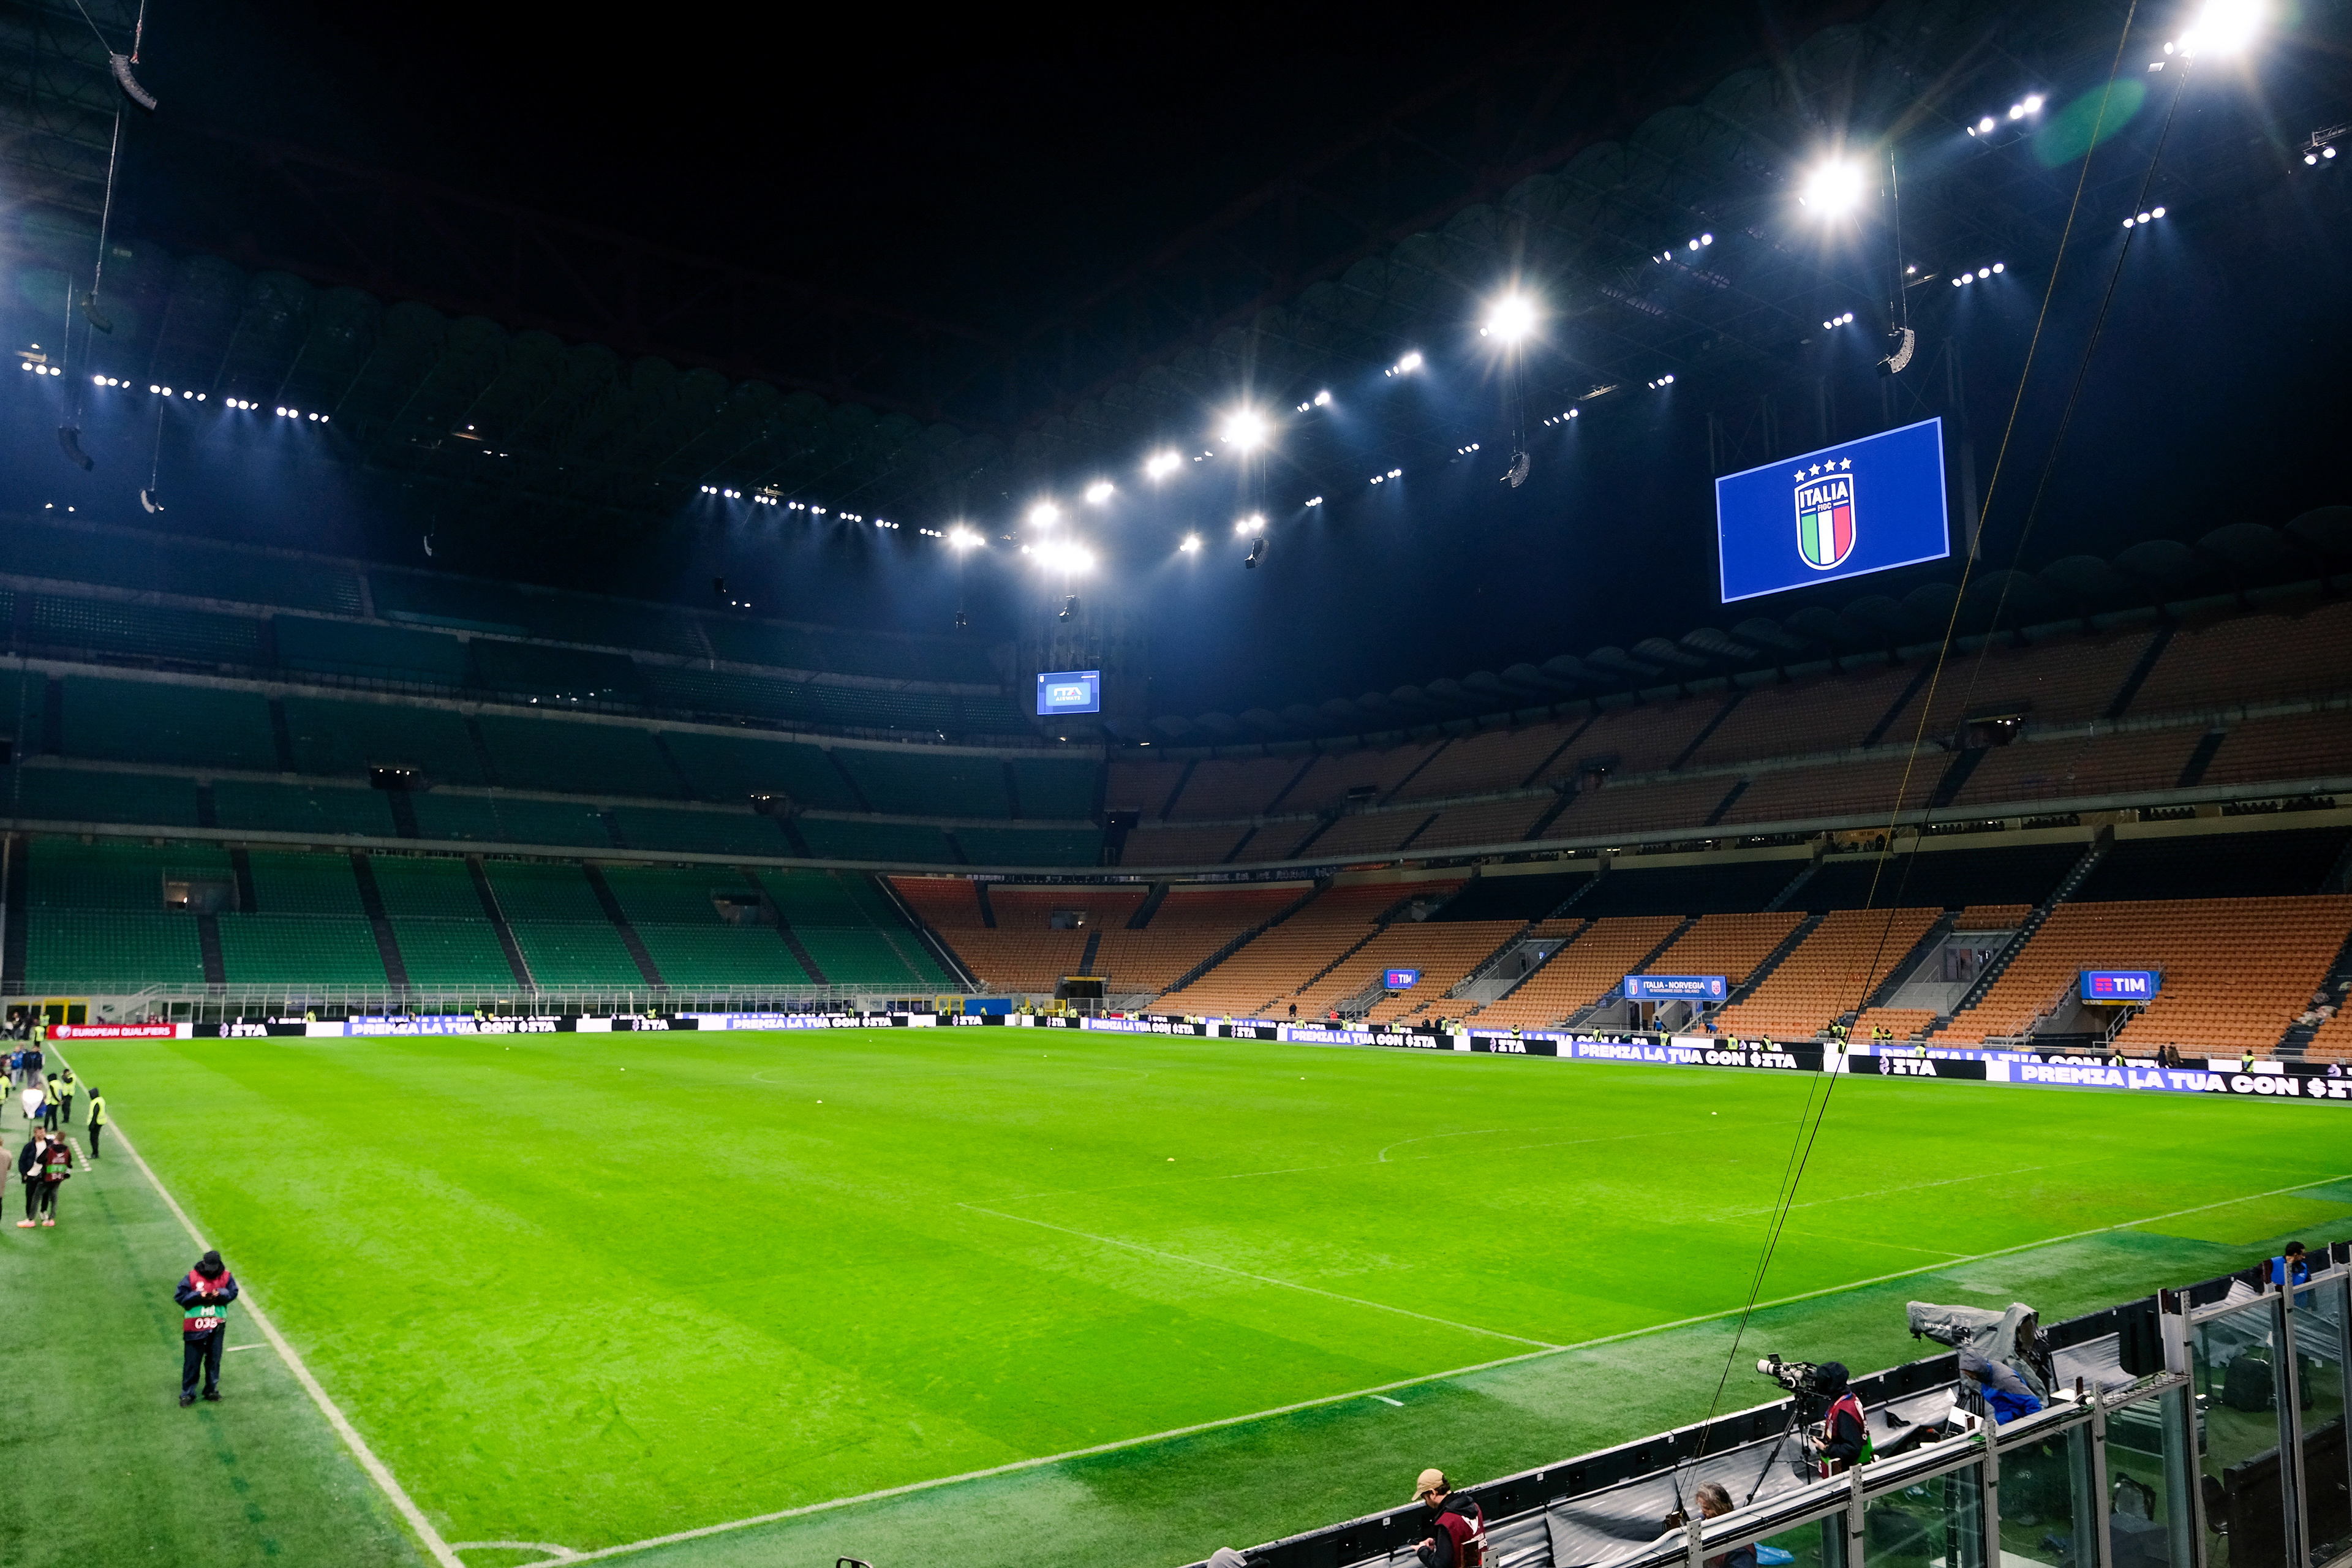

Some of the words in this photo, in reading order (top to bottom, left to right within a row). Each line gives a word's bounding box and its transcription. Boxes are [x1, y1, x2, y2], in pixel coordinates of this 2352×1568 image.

[1800, 481, 1849, 508] ITALIA
[1817, 502, 1831, 511] FIGC
[1054, 687, 1082, 696] ITA
[1398, 974, 1412, 984] TIM
[2113, 978, 2145, 992] TIM
[421, 1022, 443, 1034] LA
[445, 1022, 478, 1034] TUA
[480, 1021, 515, 1033] CON
[786, 1018, 804, 1028] LA
[805, 1017, 831, 1028] TUA
[832, 1017, 860, 1028] CON
[1123, 1022, 1134, 1031] LA
[1133, 1022, 1152, 1032] TUA
[1152, 1022, 1172, 1033] CON
[72, 1028, 119, 1037] EUROPEAN
[121, 1027, 170, 1036] QUALIFIERS
[1336, 1032, 1351, 1044] LA
[1352, 1033, 1375, 1045] TUA
[1376, 1033, 1403, 1046] CON
[1644, 1047, 1666, 1061] LA
[1668, 1049, 1703, 1064] TUA
[1705, 1050, 1746, 1066] CON
[2021, 1065, 2125, 1086] PREMIA
[2128, 1069, 2166, 1088] LA
[2168, 1072, 2228, 1092] TUA
[2231, 1075, 2300, 1096] CON
